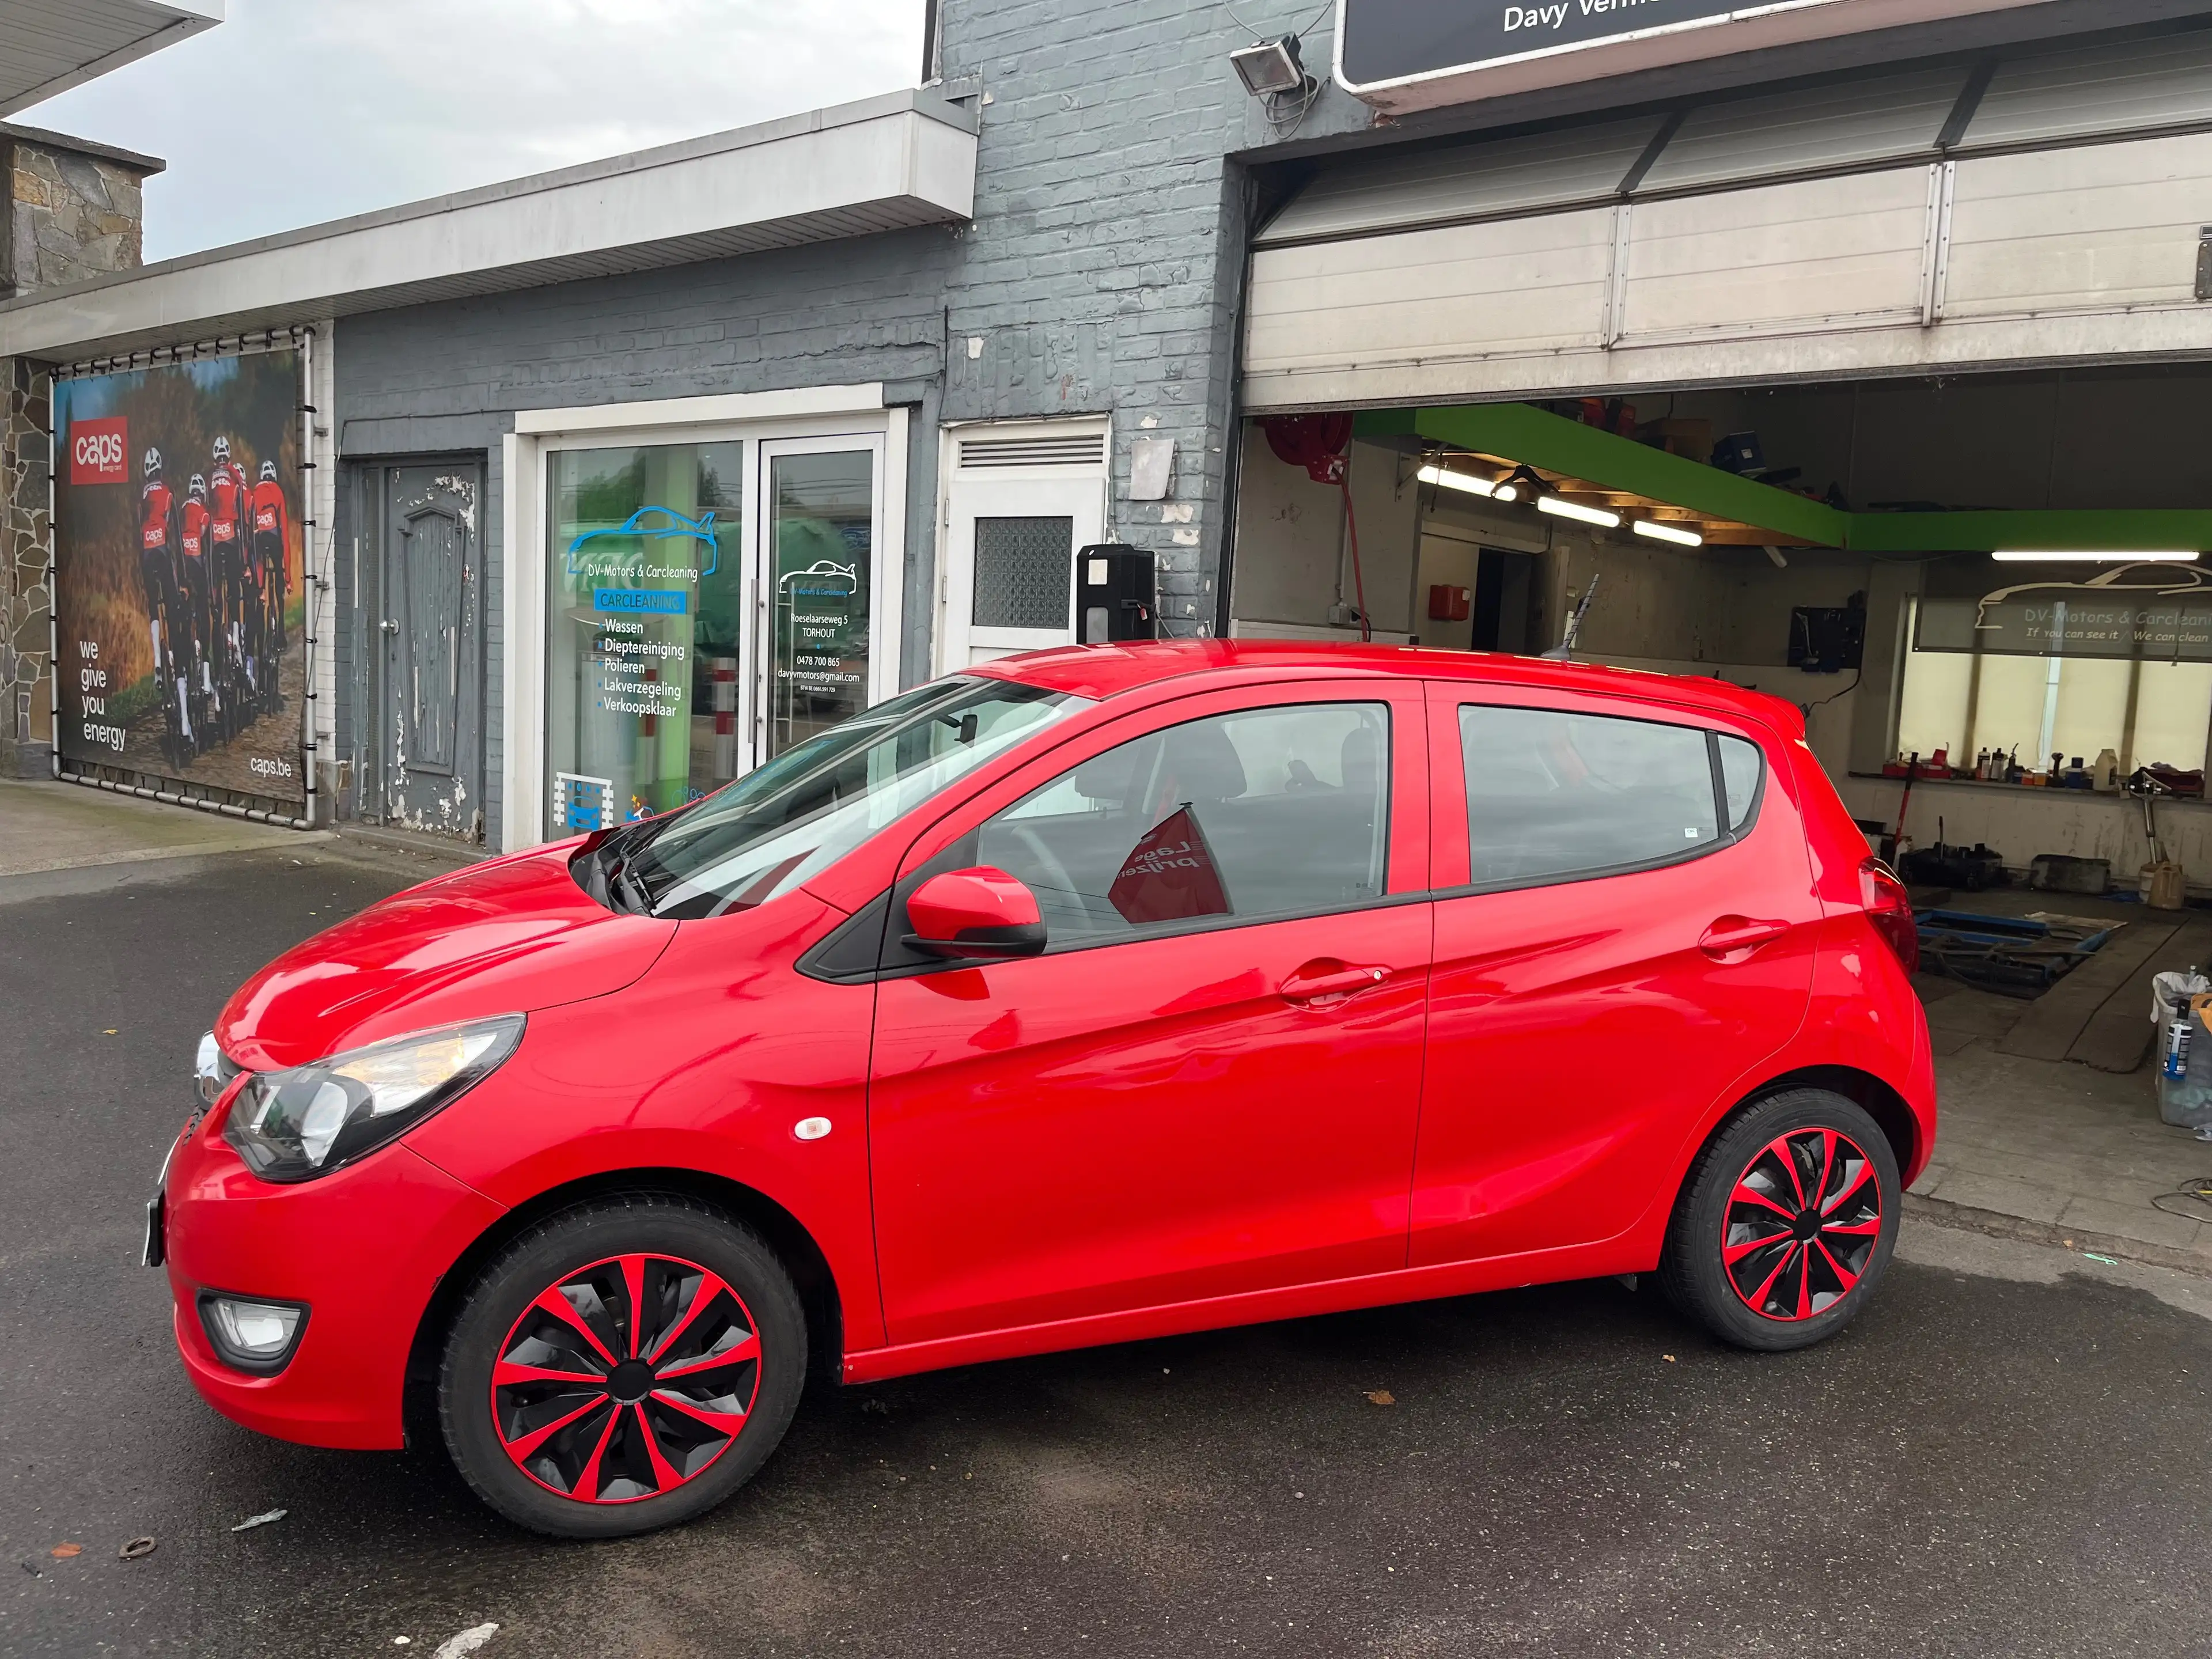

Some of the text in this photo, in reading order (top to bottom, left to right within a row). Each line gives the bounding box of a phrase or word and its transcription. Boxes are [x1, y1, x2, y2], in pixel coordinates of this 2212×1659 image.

[1503, 2, 1569, 32] Davy
[76, 433, 122, 472] caps
[146, 528, 162, 543] caps
[213, 522, 230, 537] caps
[588, 564, 698, 583] DV-Motors & Carcleaning
[600, 593, 680, 611] CARCLEANING
[790, 613, 849, 627] Roeselaarseweg 5
[2025, 608, 2113, 624] DV-Motors
[2118, 611, 2130, 624] &
[605, 618, 643, 634] Wassen
[802, 627, 836, 638] TORHOUT
[2027, 627, 2039, 637] If
[2086, 631, 2106, 639] see
[2108, 630, 2119, 639] it
[2134, 630, 2152, 641] We
[2178, 632, 2209, 642] clean
[79, 641, 99, 660] we
[605, 638, 685, 661] Dieptereiniging
[605, 657, 645, 674] Polieren
[797, 656, 840, 666] 0478 700 865
[81, 663, 107, 692] give
[778, 668, 860, 683] davyvmotors@gmail.com
[604, 677, 682, 701] Lakverzegeling
[82, 695, 105, 719] you
[604, 696, 677, 718] Verkoopsklaar
[84, 722, 126, 752] energy
[251, 757, 291, 778] caps.be
